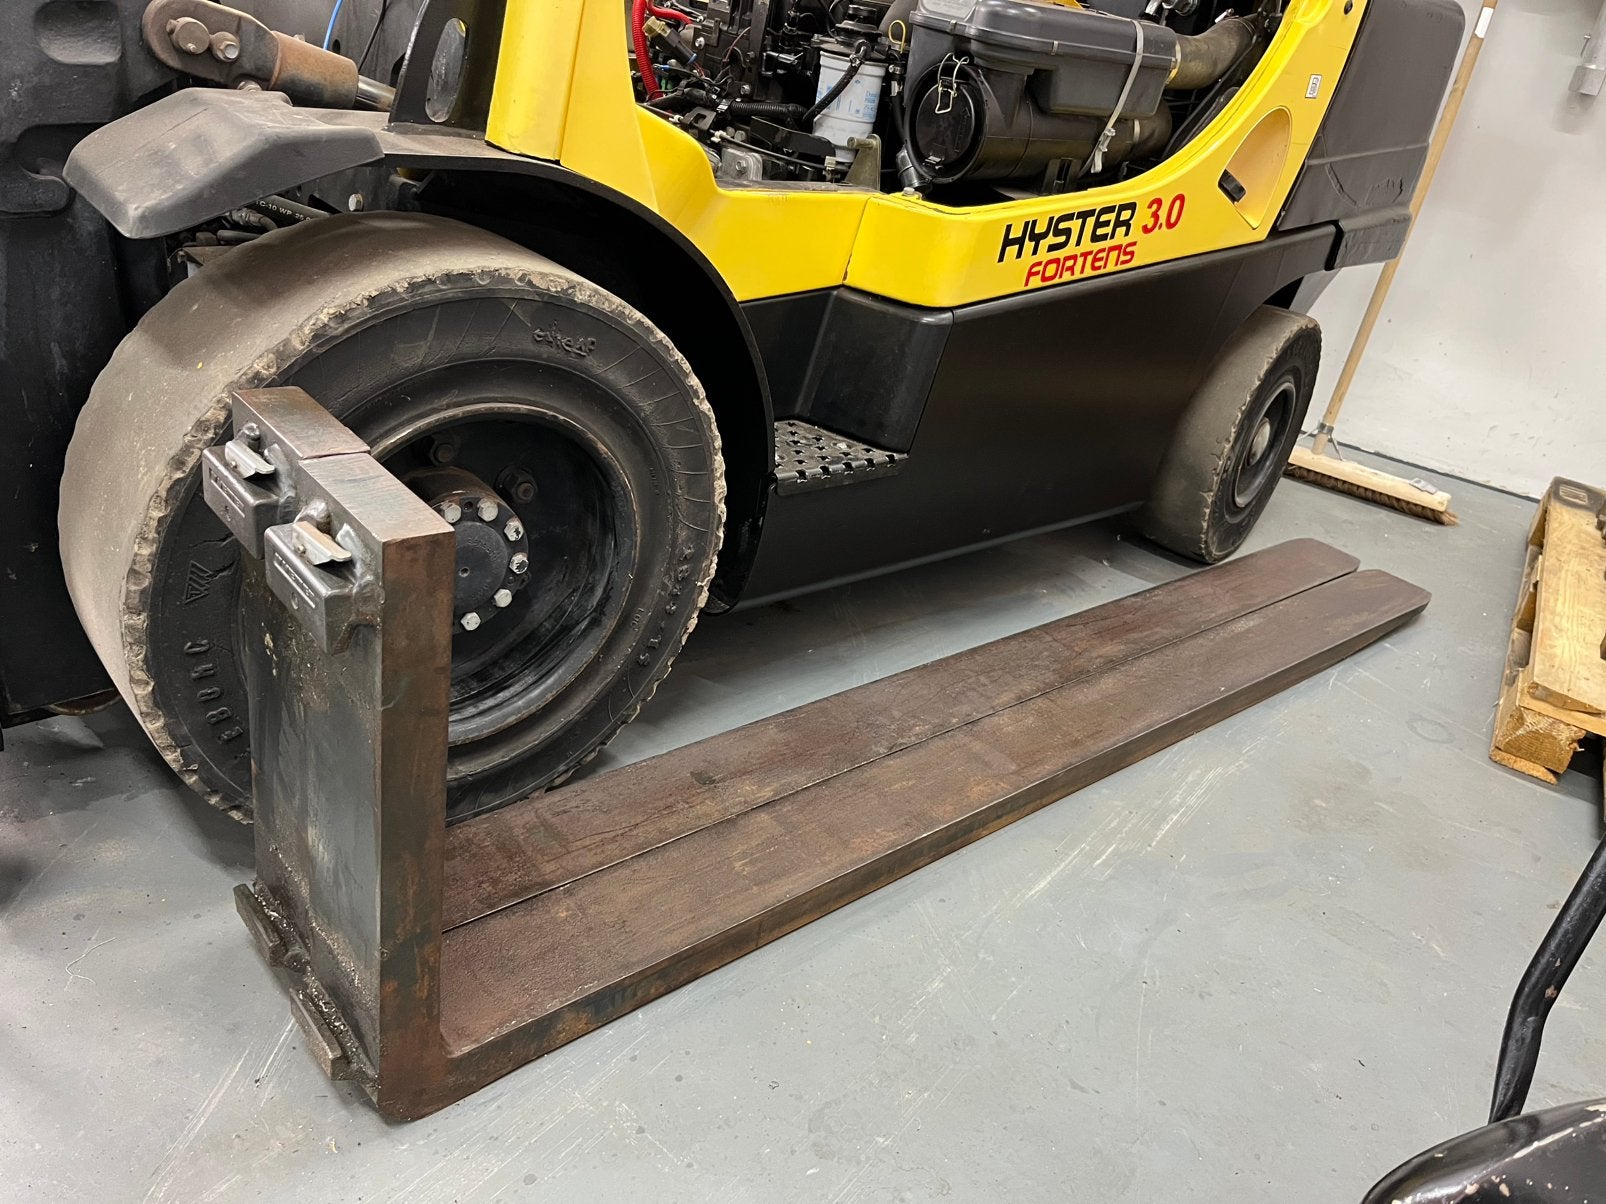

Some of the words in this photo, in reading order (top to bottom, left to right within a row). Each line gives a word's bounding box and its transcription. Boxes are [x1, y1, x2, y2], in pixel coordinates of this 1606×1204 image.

[997, 201, 1138, 264] HYSTER
[1141, 193, 1186, 235] 3.0
[1024, 241, 1138, 287] FORTENS
